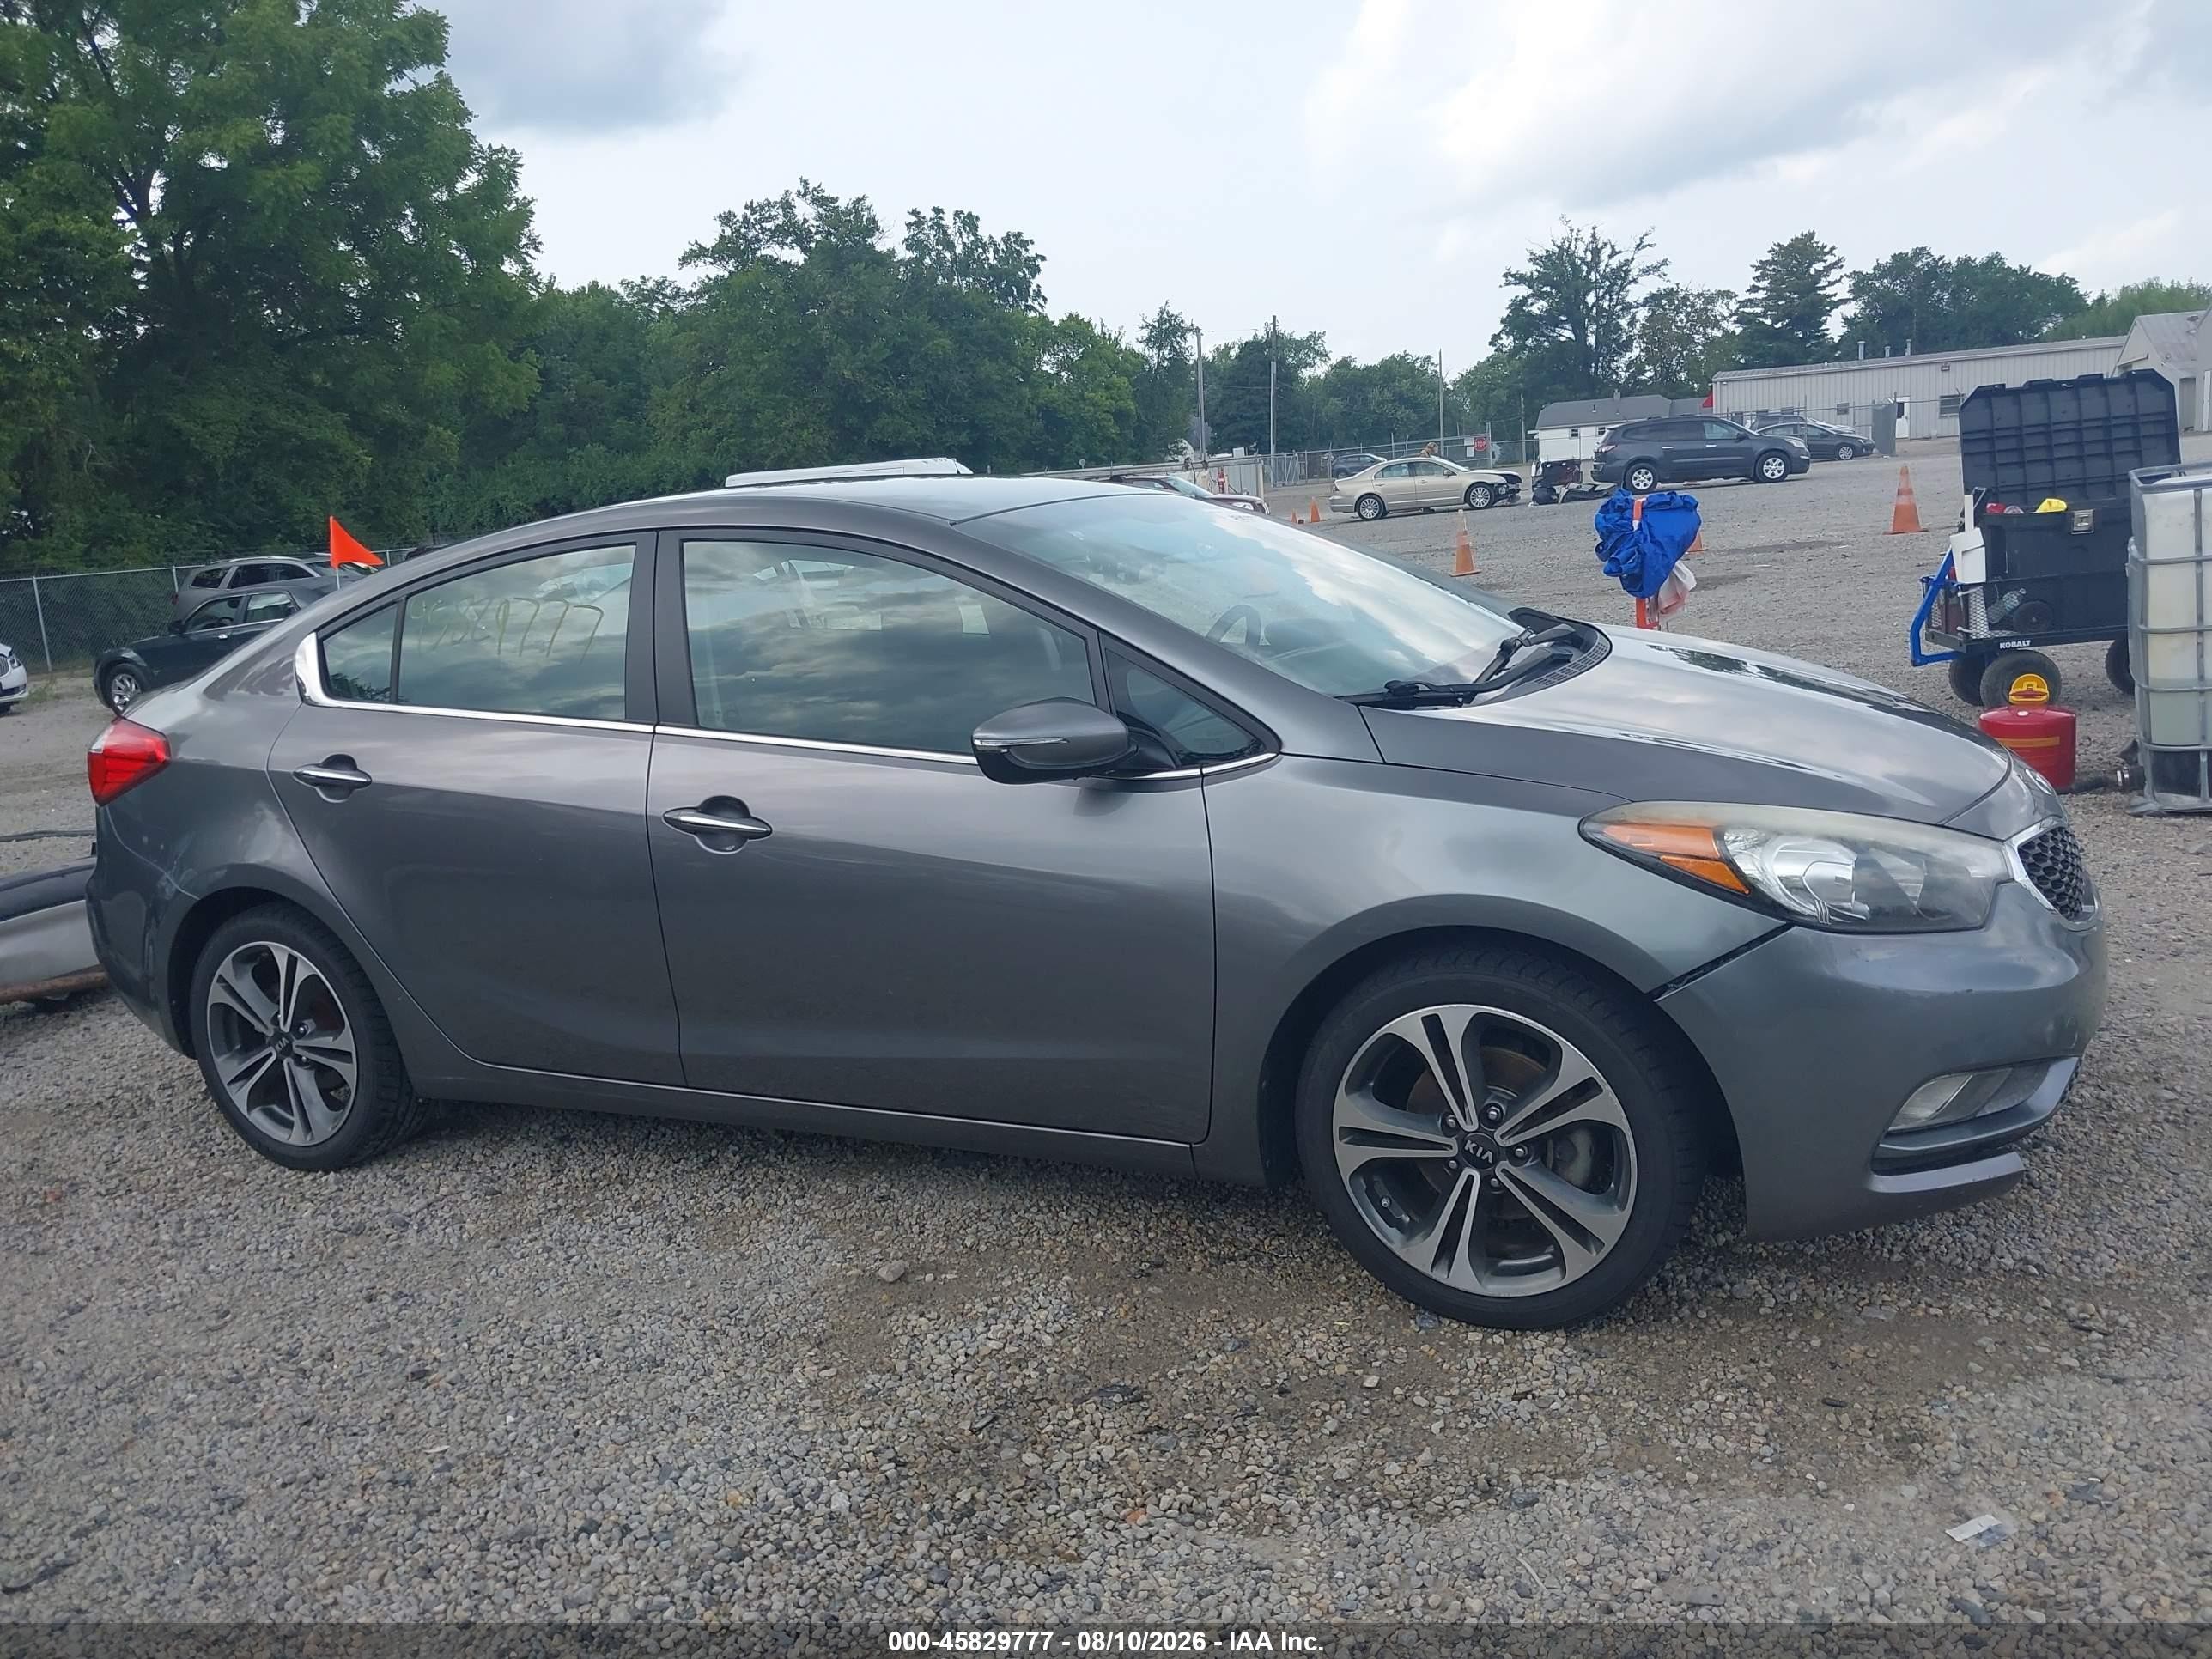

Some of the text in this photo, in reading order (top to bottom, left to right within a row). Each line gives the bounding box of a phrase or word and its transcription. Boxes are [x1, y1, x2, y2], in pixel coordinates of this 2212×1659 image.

[1999, 640, 2032, 649] KOBALT
[276, 1037, 289, 1052] KIA
[1464, 1139, 1492, 1164] KIA
